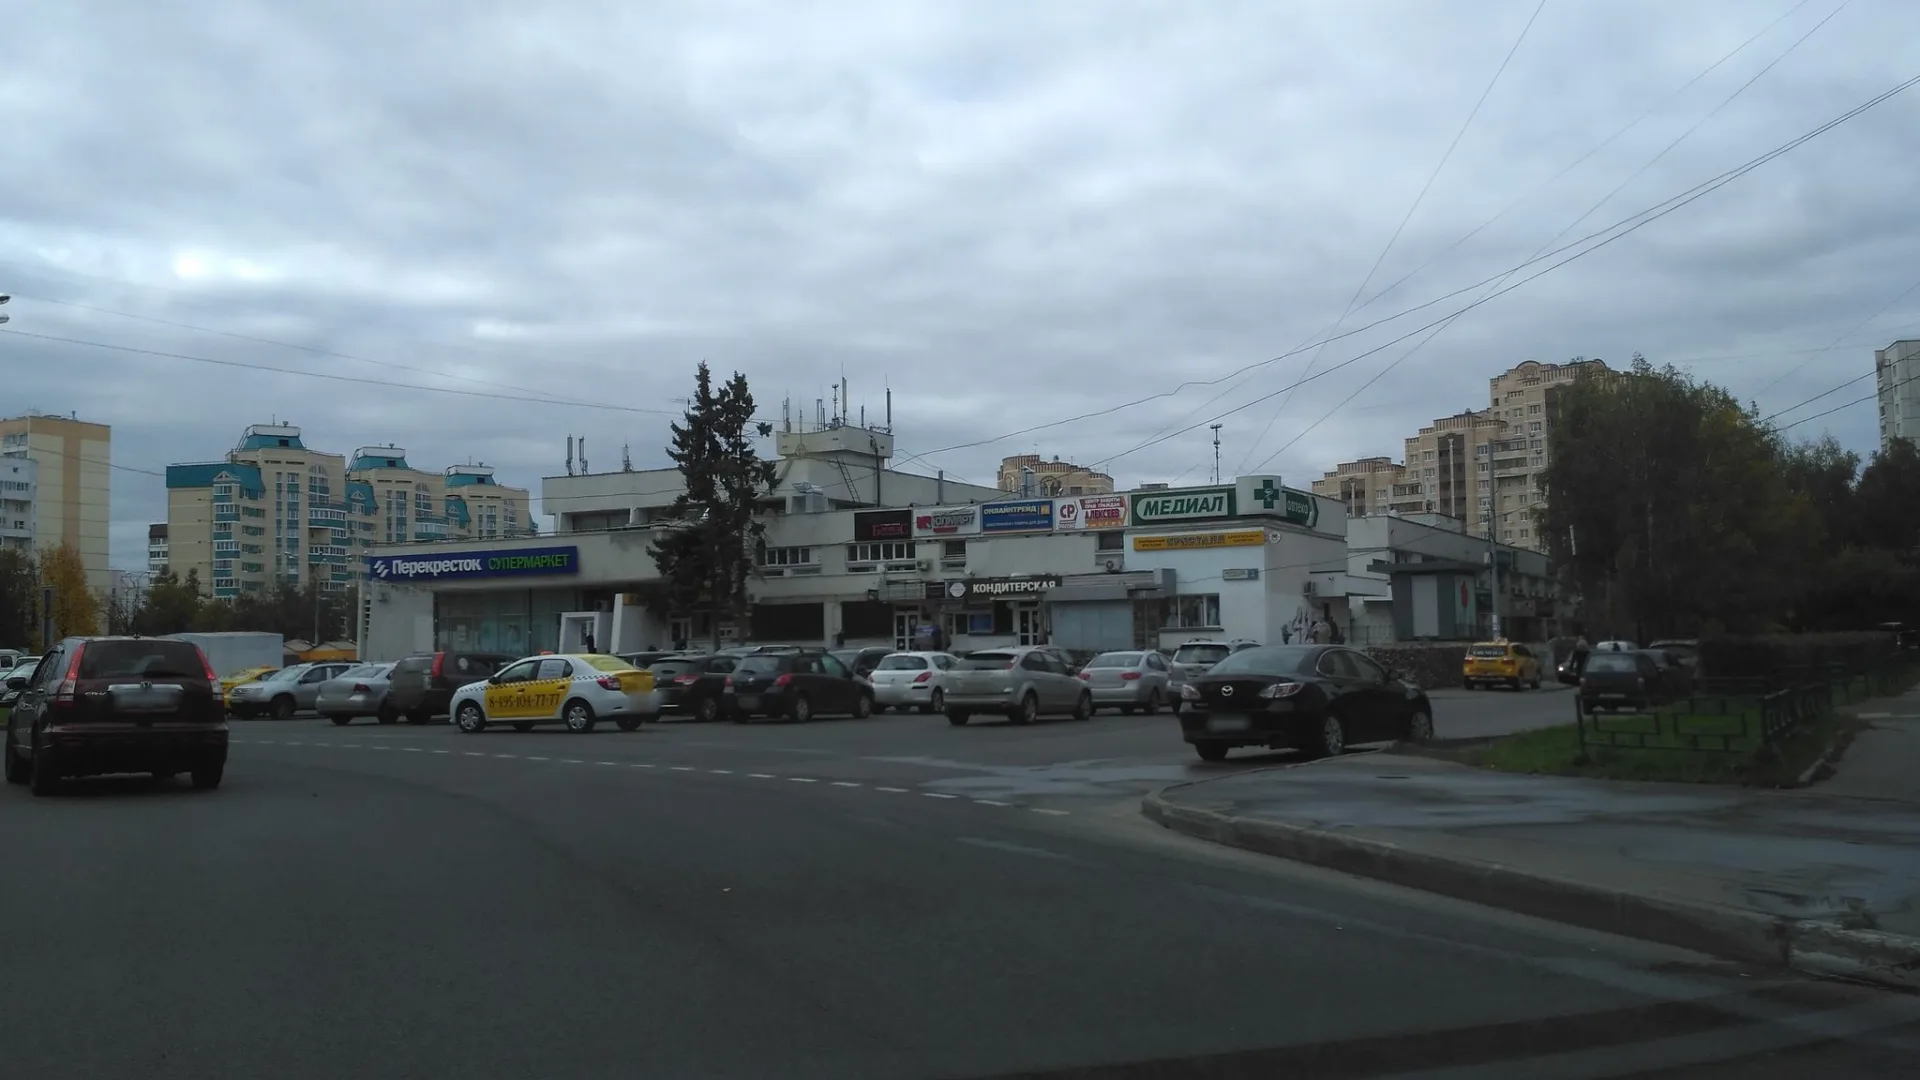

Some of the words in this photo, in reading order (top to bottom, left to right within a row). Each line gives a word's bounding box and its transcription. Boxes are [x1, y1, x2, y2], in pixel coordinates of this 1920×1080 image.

[983, 504, 1037, 515] ОНЛАЙНТРЕЙД
[1143, 494, 1224, 517] МЕДИАЛ
[1084, 508, 1120, 519] АЛЕКСЕЕВ
[391, 558, 483, 578] Перекресток
[487, 553, 569, 570] СУПЕРМАРКЕТ
[972, 580, 1056, 595] КОНДИТЕРСКАЯ
